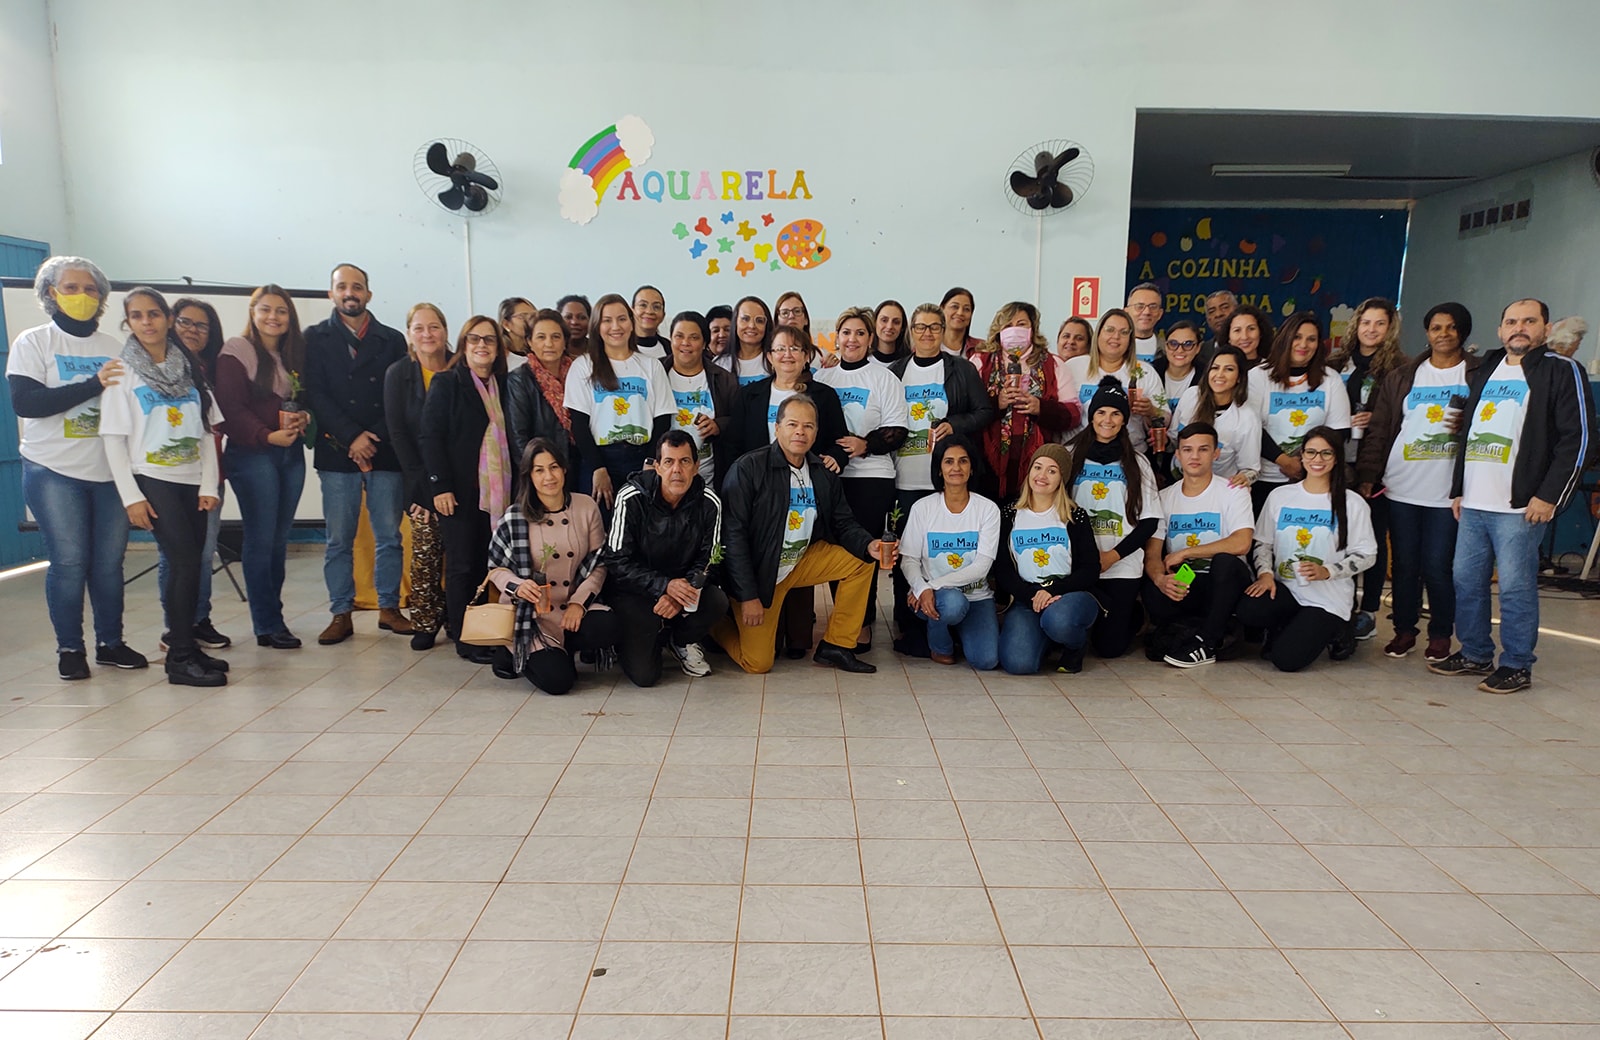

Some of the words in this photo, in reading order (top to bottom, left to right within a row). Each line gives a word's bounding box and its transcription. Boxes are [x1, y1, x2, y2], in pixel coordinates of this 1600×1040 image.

[616, 170, 813, 203] AQUARELA
[1140, 261, 1154, 279] A
[1167, 258, 1270, 279] COZINHA
[1165, 293, 1273, 313] PEQNA
[1181, 521, 1192, 529] de
[942, 540, 954, 548] de
[1027, 536, 1038, 544] de
[1041, 532, 1066, 542] Maio
